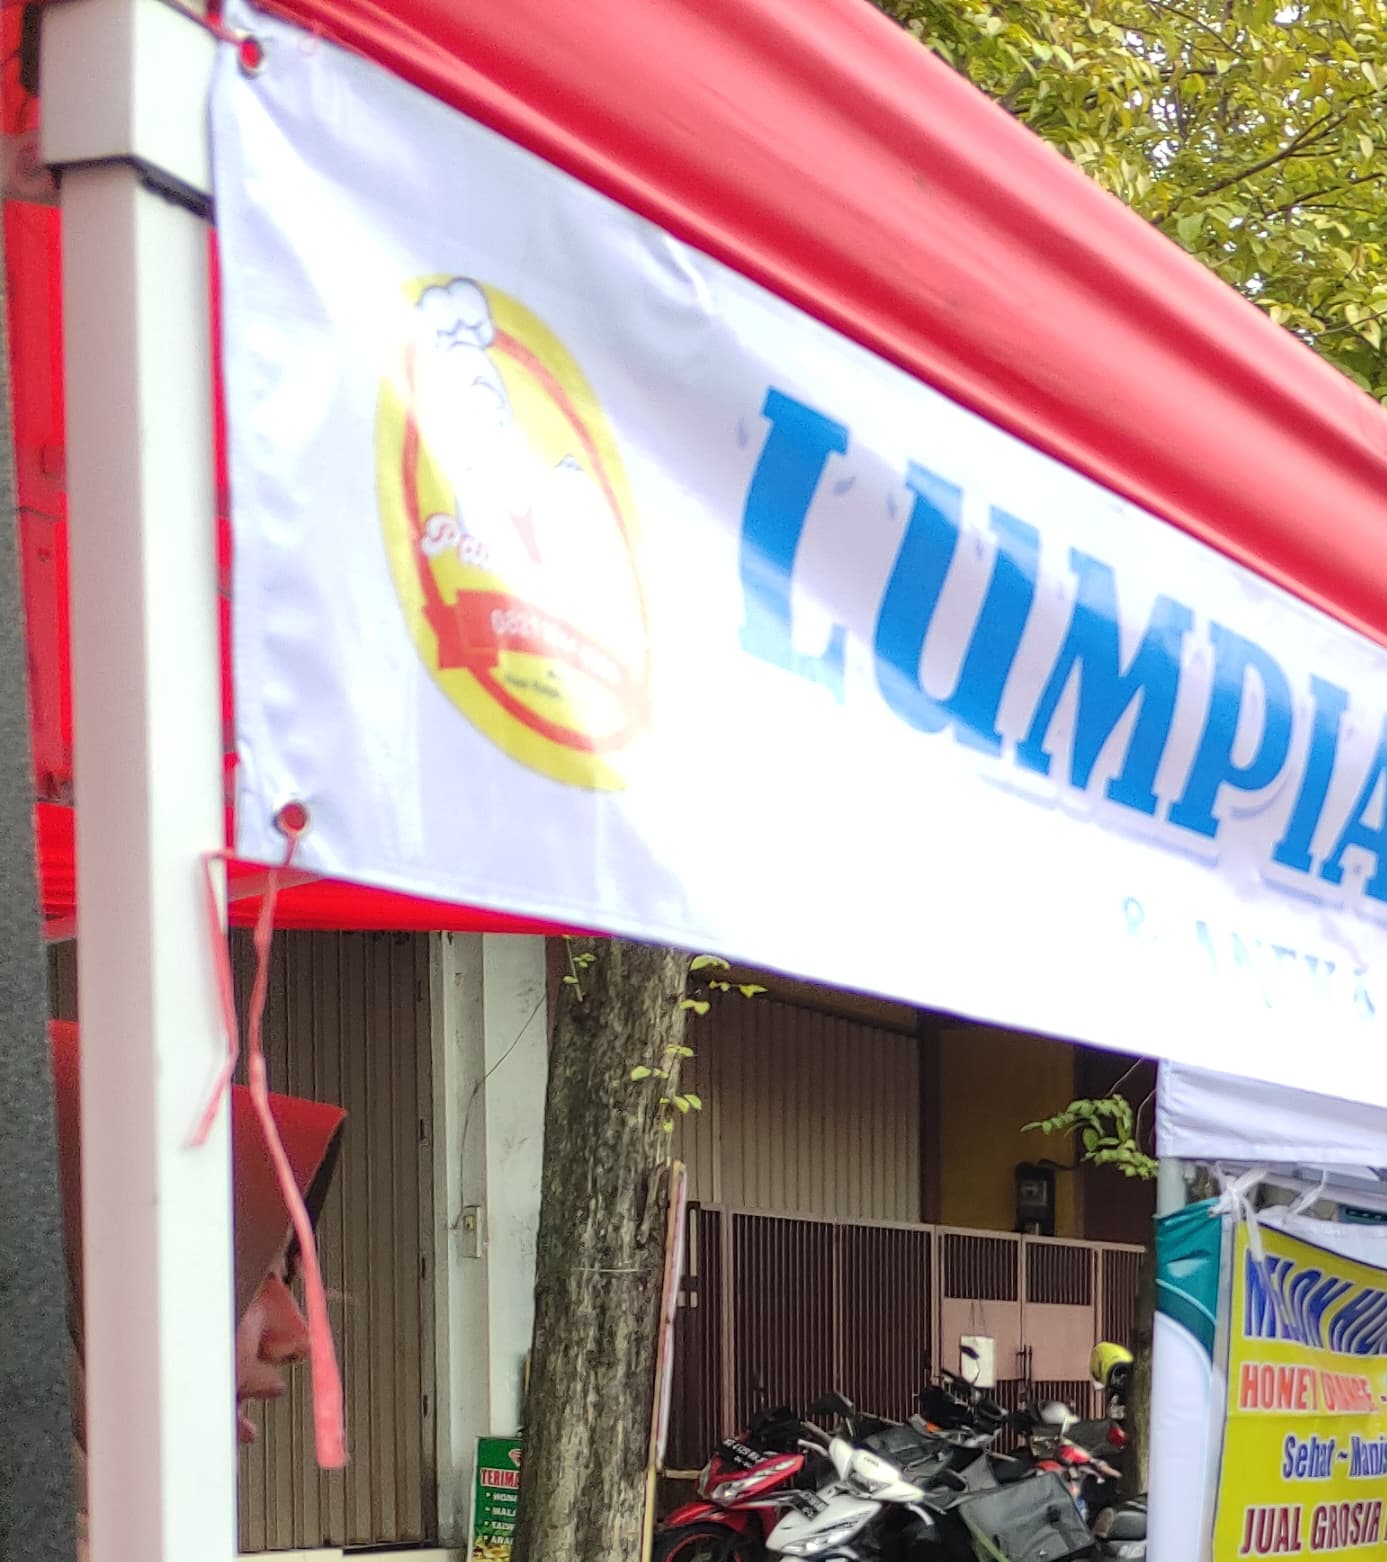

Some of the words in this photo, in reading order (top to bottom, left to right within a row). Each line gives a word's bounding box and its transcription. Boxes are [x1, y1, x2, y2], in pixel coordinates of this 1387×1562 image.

[1241, 1364, 1318, 1411] HONEY
[1240, 1506, 1302, 1555] JUAL
[1310, 1500, 1382, 1550] GROSIR
